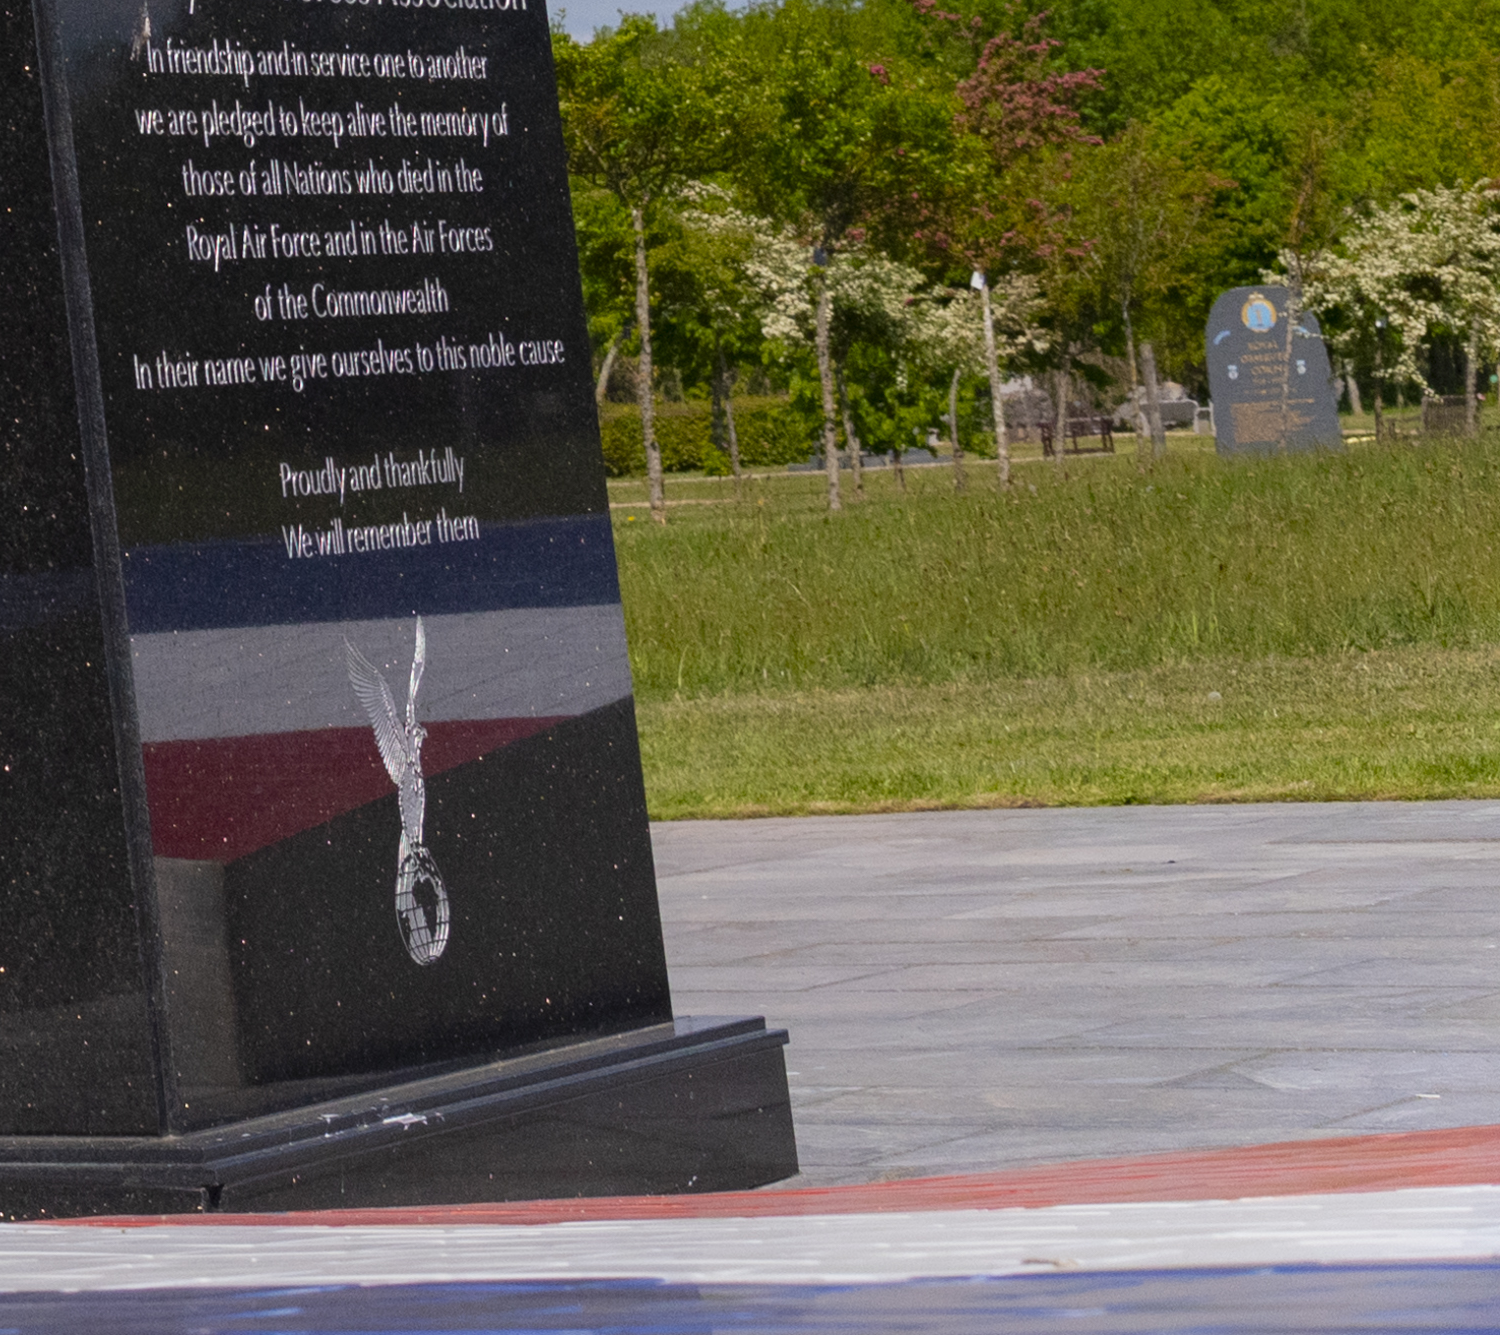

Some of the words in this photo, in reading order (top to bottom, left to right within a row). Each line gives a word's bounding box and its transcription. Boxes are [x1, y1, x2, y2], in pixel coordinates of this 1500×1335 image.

[147, 38, 164, 73] In
[167, 37, 255, 88] friendship
[257, 40, 290, 76] and
[291, 43, 309, 76] in
[311, 44, 370, 77] service
[374, 53, 405, 77] one
[407, 49, 424, 78] to
[427, 45, 487, 79] another
[134, 108, 164, 135] we
[168, 109, 198, 135] are
[202, 99, 276, 148] pledged
[279, 105, 297, 136] to
[299, 96, 343, 148] keep
[347, 101, 387, 137] alive
[388, 101, 417, 137] the
[420, 112, 488, 147] memory
[492, 101, 509, 137] of
[182, 158, 235, 196] those
[239, 158, 257, 196] of
[261, 158, 282, 195] all
[283, 160, 352, 195] Nations
[355, 158, 393, 194] who
[397, 157, 434, 193] died
[436, 160, 453, 192] in
[455, 157, 484, 192] the
[186, 222, 237, 272] Royal
[242, 224, 267, 259] Air
[271, 223, 321, 258] Force
[324, 219, 358, 256] and
[359, 221, 377, 255] in
[379, 218, 408, 254] the
[412, 220, 435, 253] Air
[438, 219, 494, 252] Forces
[254, 283, 273, 321] of
[278, 282, 308, 320] the
[311, 277, 449, 318] Commonwealth
[133, 353, 153, 390] In
[155, 350, 198, 388] their
[204, 357, 256, 385] name
[258, 355, 286, 381] we
[290, 345, 327, 392] give
[331, 338, 413, 377] ourselves
[416, 342, 434, 372] to
[436, 335, 467, 371] this
[469, 331, 516, 368] noble
[519, 339, 565, 366] cause
[279, 456, 345, 504] Proudly
[349, 453, 382, 491] and
[384, 446, 464, 493] thankfully
[281, 523, 313, 559] We
[315, 517, 345, 555] will
[347, 511, 432, 553] remember
[436, 507, 479, 544] them
